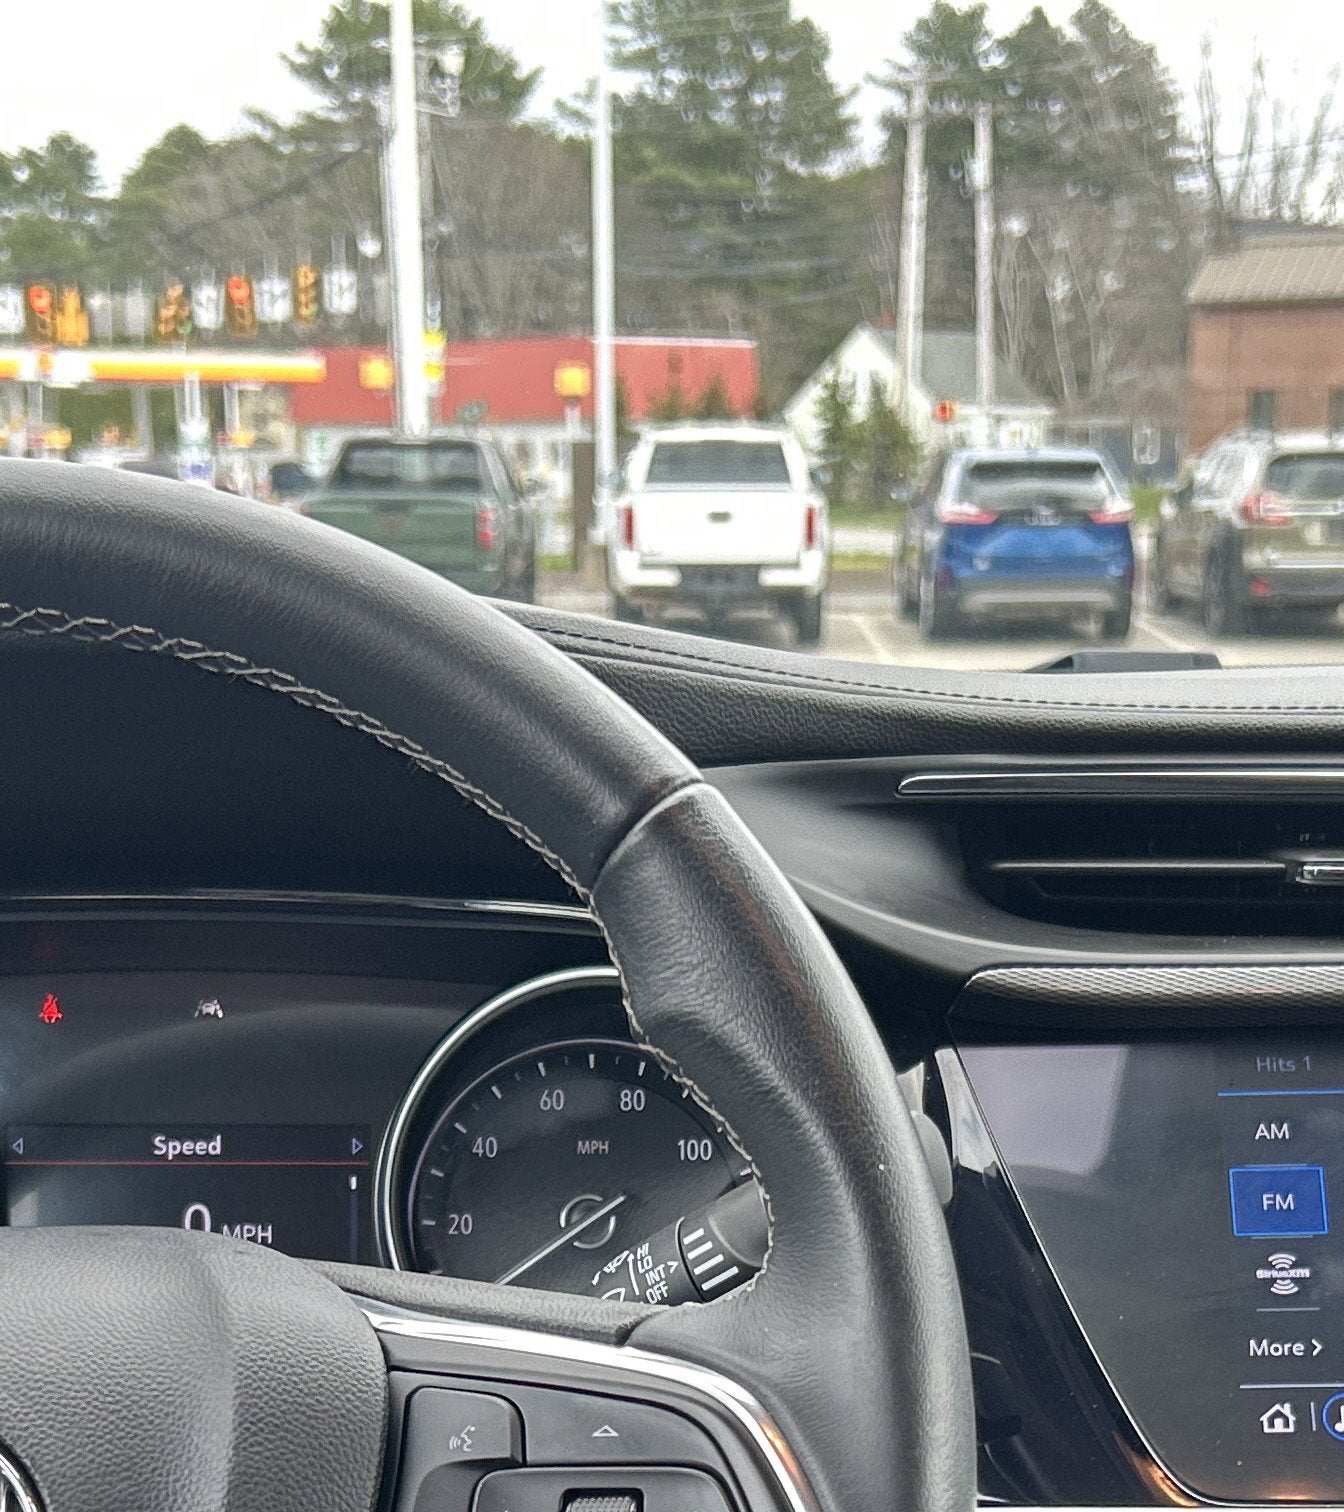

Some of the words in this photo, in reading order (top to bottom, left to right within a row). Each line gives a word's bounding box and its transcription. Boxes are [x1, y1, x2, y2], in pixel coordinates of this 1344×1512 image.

[1256, 1056, 1296, 1073] Hits
[1303, 1055, 1312, 1072] 1
[539, 1090, 565, 1112] 60
[619, 1090, 646, 1112] 80
[1254, 1123, 1291, 1140] AM
[153, 1134, 222, 1160] Speed
[471, 1135, 498, 1159] 40
[577, 1140, 609, 1156] MPH
[677, 1139, 713, 1162] 100
[1262, 1193, 1296, 1211] FM
[222, 1223, 273, 1244] MPH
[447, 1213, 473, 1236] 20
[637, 1242, 649, 1260] HI
[637, 1255, 653, 1274] LO
[645, 1263, 666, 1287] INT
[645, 1280, 669, 1305] OFF
[1249, 1337, 1306, 1357] More
